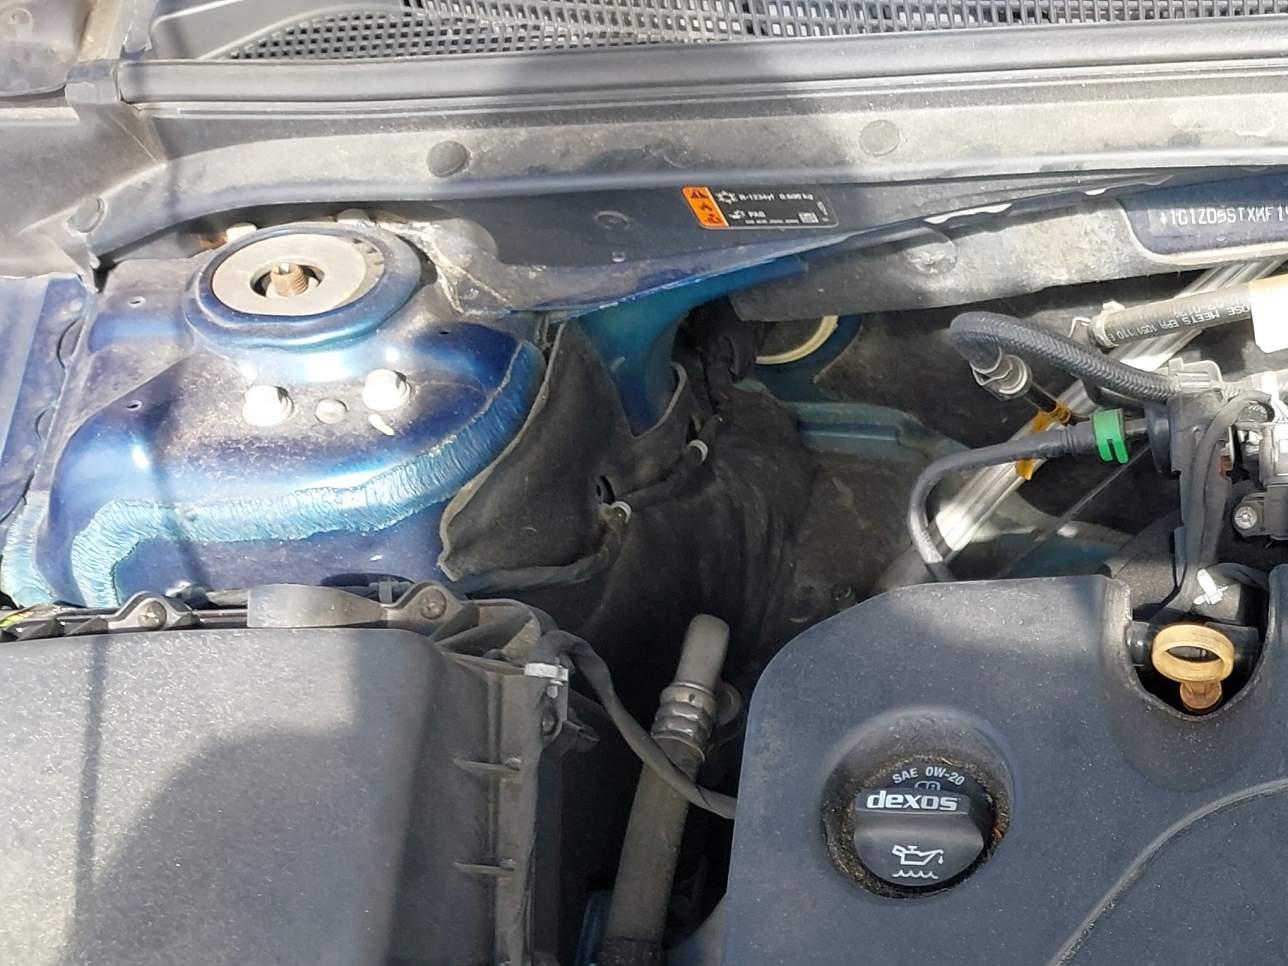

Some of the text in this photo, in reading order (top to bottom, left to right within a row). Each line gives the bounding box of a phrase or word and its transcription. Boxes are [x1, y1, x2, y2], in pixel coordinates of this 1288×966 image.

[892, 766, 966, 786] SAE 0W-20
[866, 790, 959, 811] dexos
